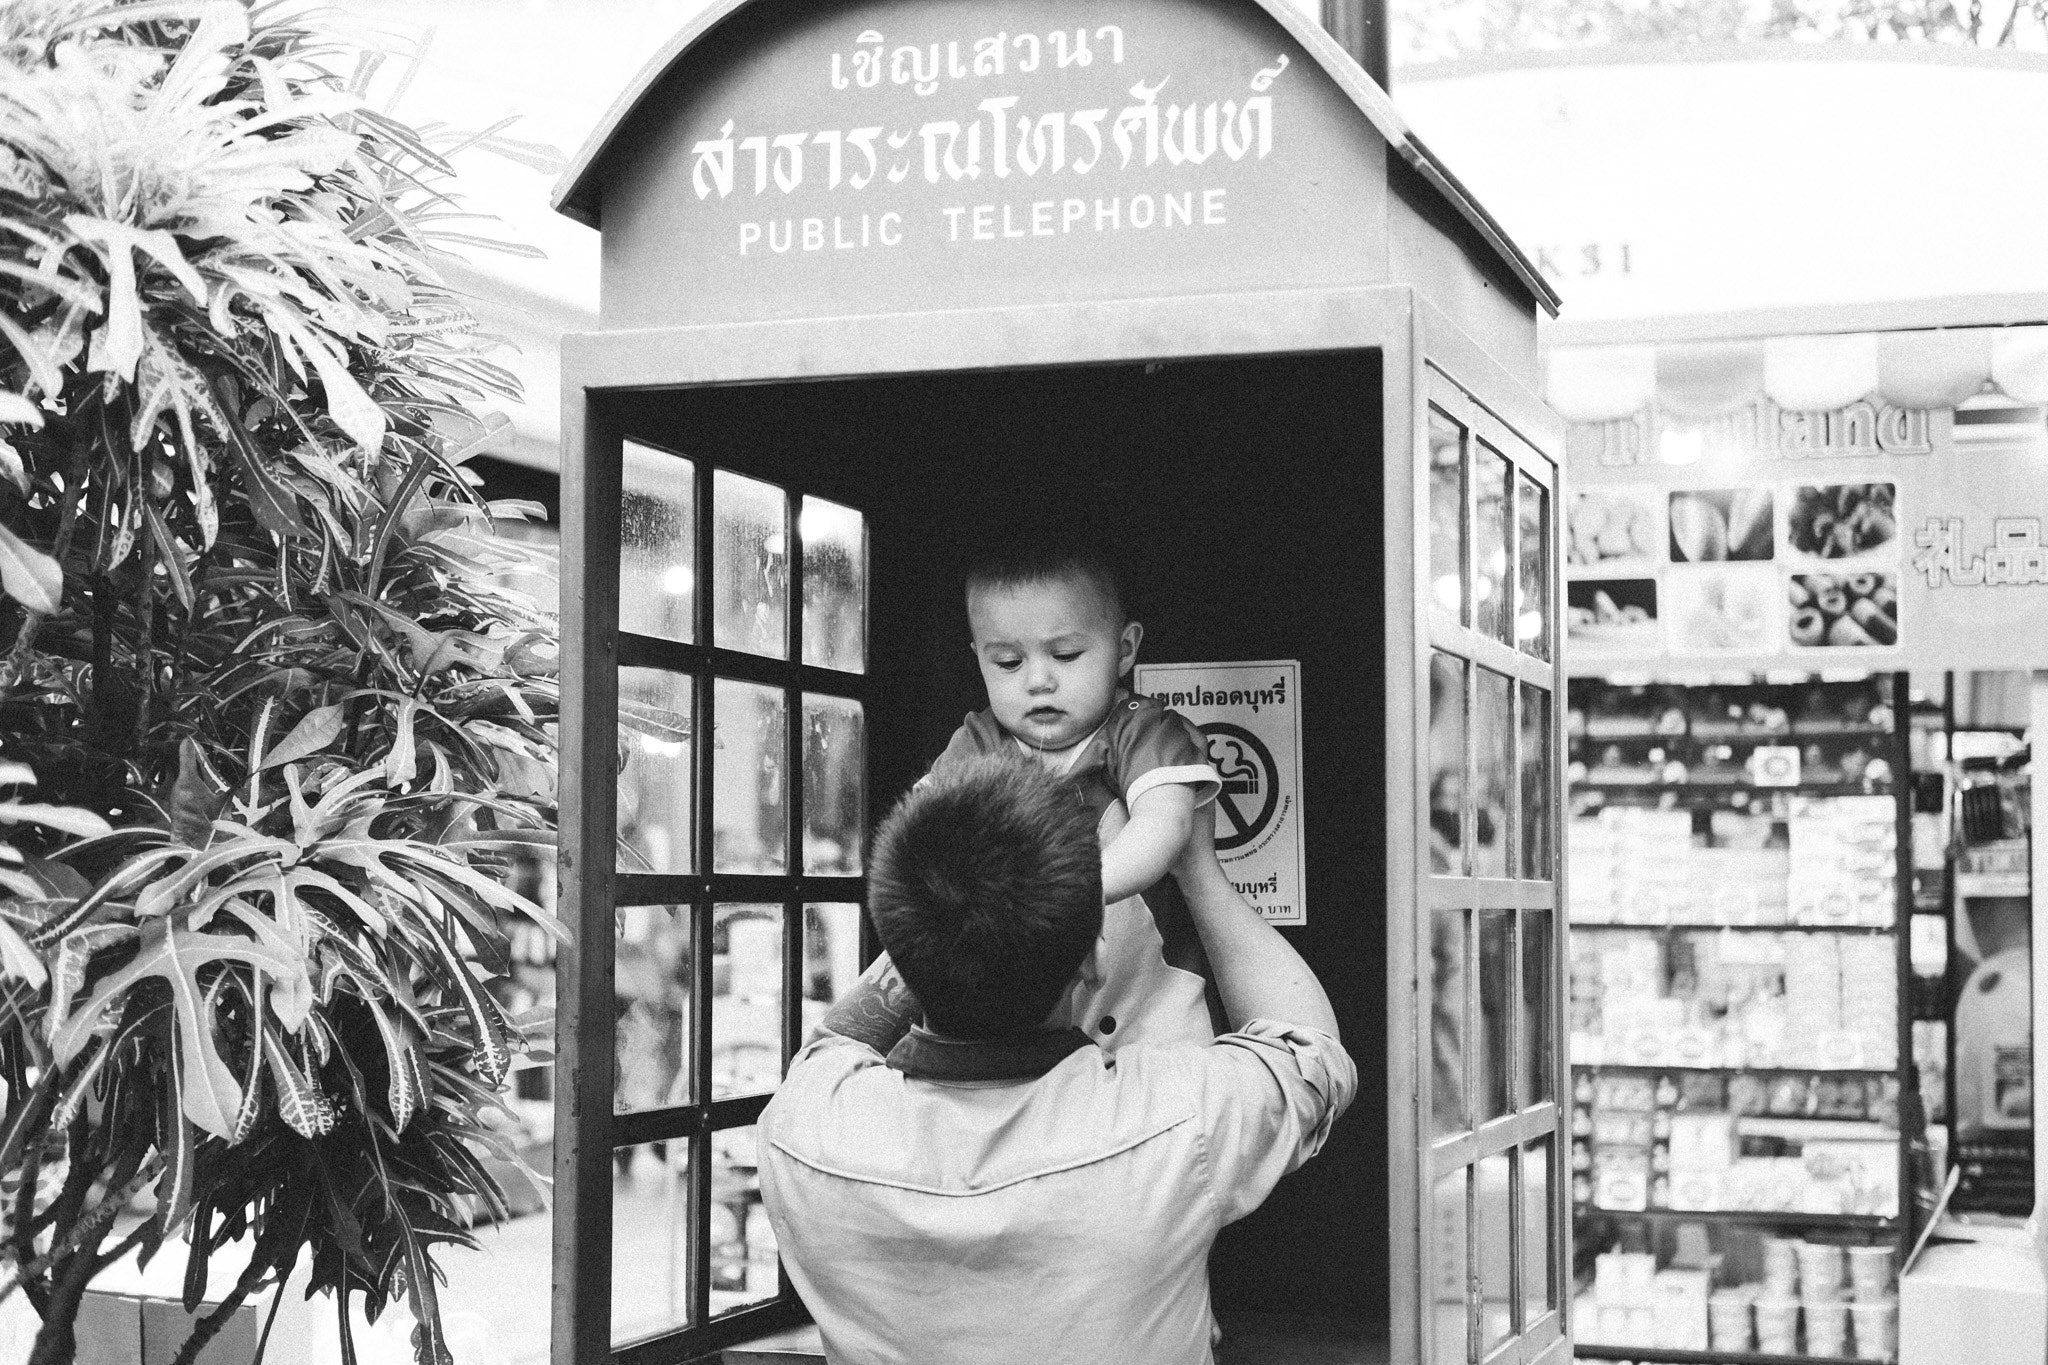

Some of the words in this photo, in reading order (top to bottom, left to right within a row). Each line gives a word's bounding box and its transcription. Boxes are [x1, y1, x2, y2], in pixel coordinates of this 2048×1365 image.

[831, 25, 1124, 96] เชิญเสวนา
[739, 211, 904, 256] PUBLIC
[942, 188, 1228, 242] TELEPHONE
[1230, 872, 1278, 900] บบุหรี่
[1267, 905, 1291, 914] บาท
